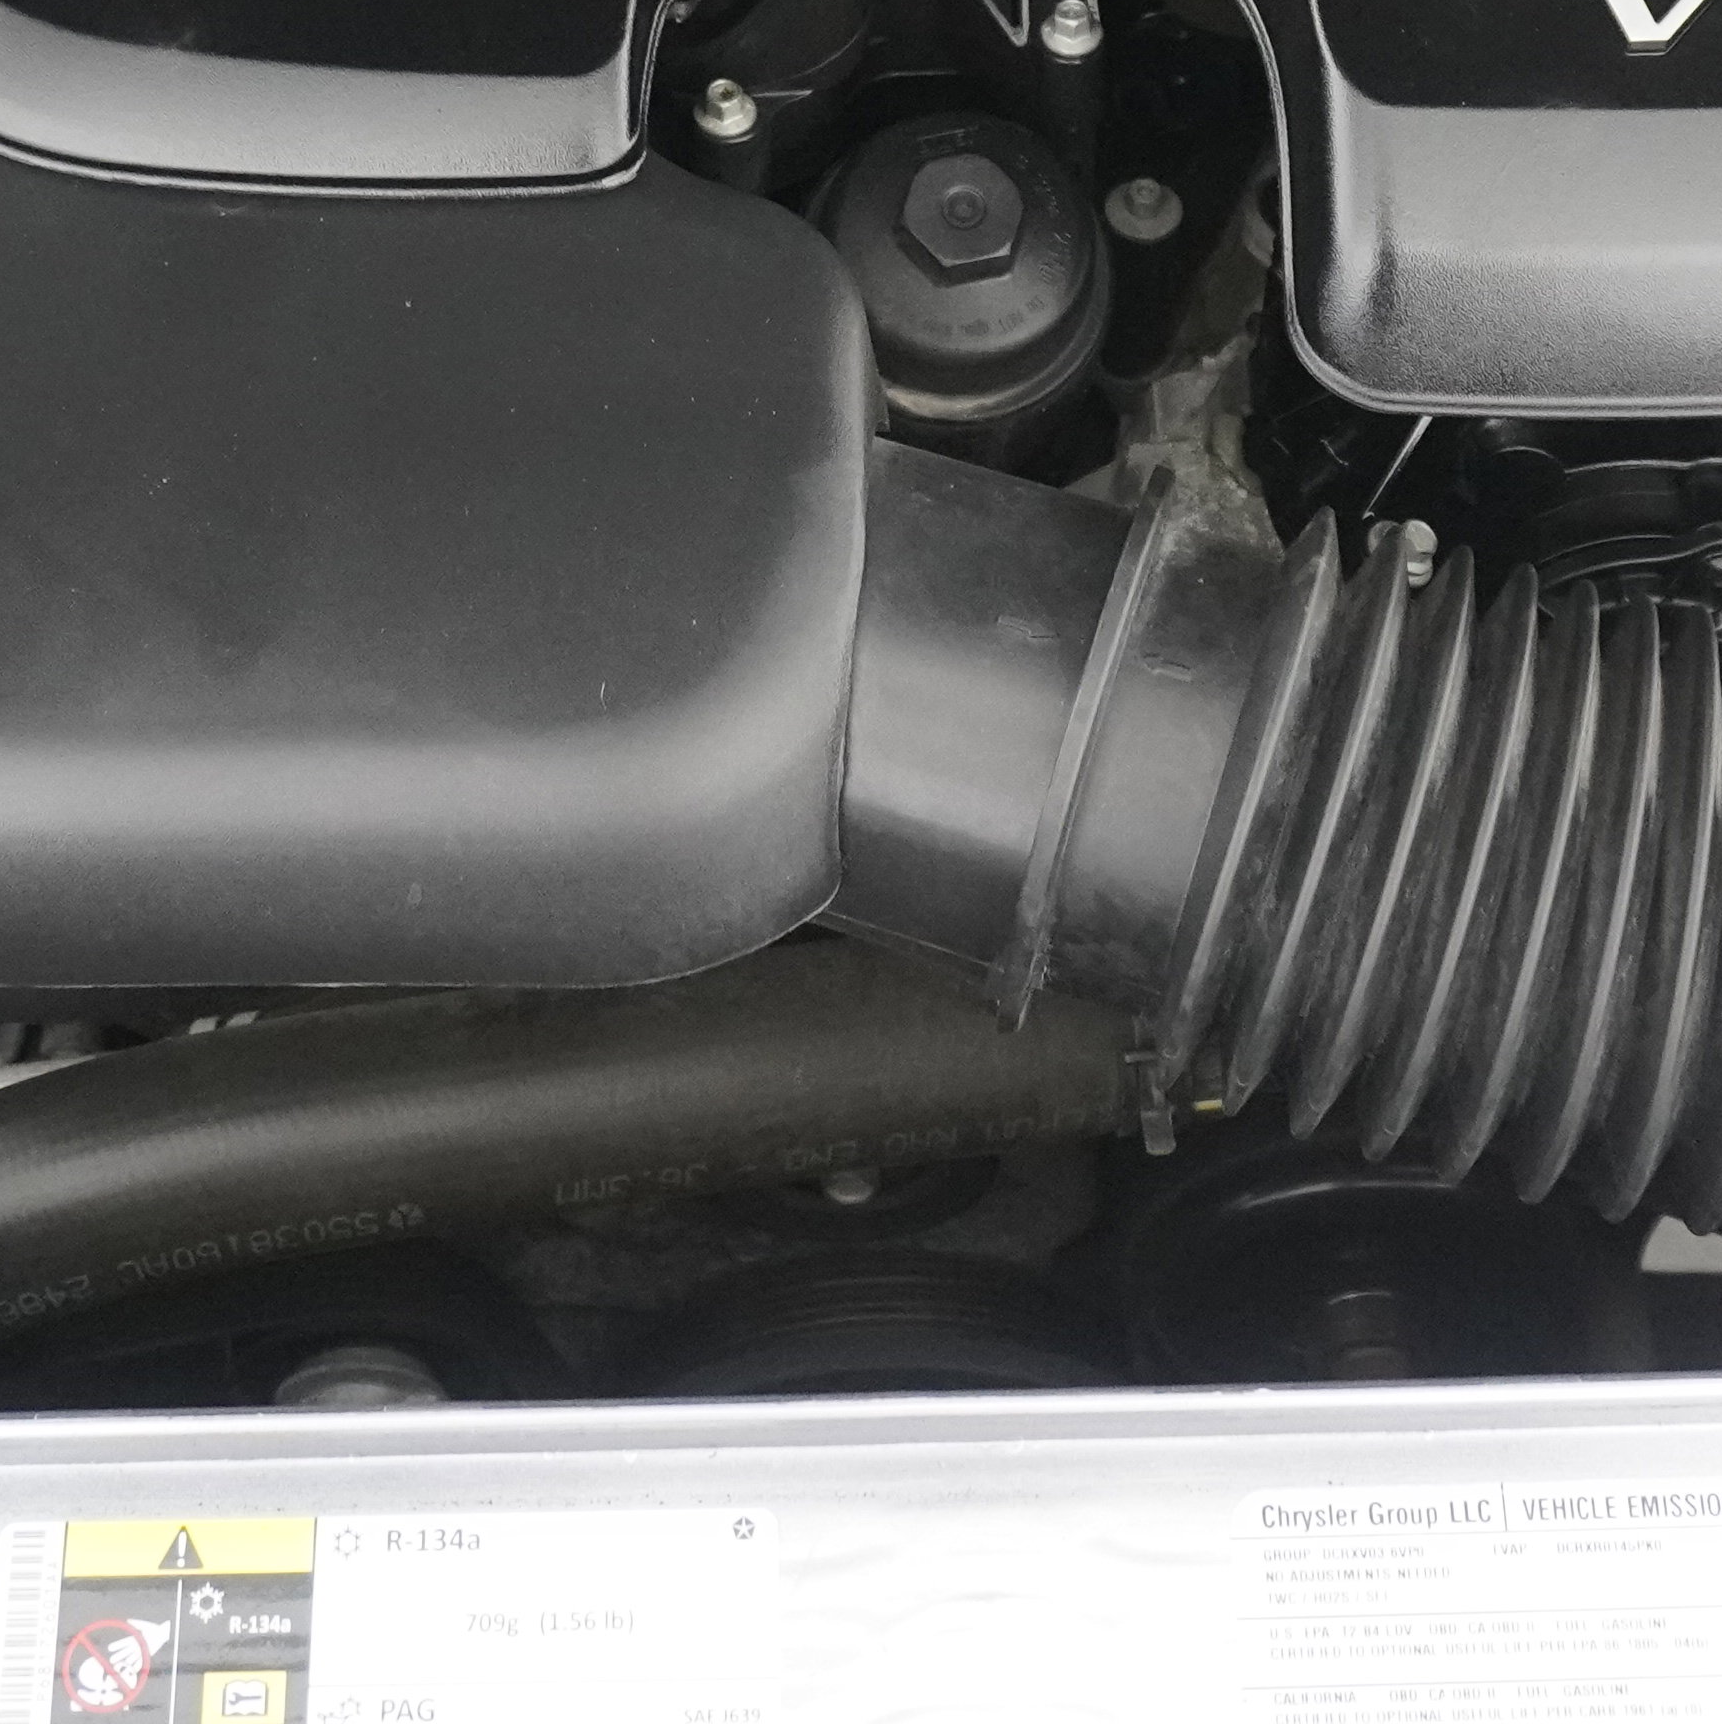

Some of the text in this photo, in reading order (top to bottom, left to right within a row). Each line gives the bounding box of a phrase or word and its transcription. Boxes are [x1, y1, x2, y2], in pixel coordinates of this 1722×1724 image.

[1262, 1499, 1491, 1532] Chrysler Group LLC
[1523, 1496, 1616, 1520] VEHICLE
[387, 1529, 480, 1551] R-134a
[1264, 1548, 1310, 1562] GROUP
[229, 1614, 292, 1634] R-134a
[467, 1610, 633, 1637] 709g (1.56 lb)
[381, 1699, 434, 1722] PAG
